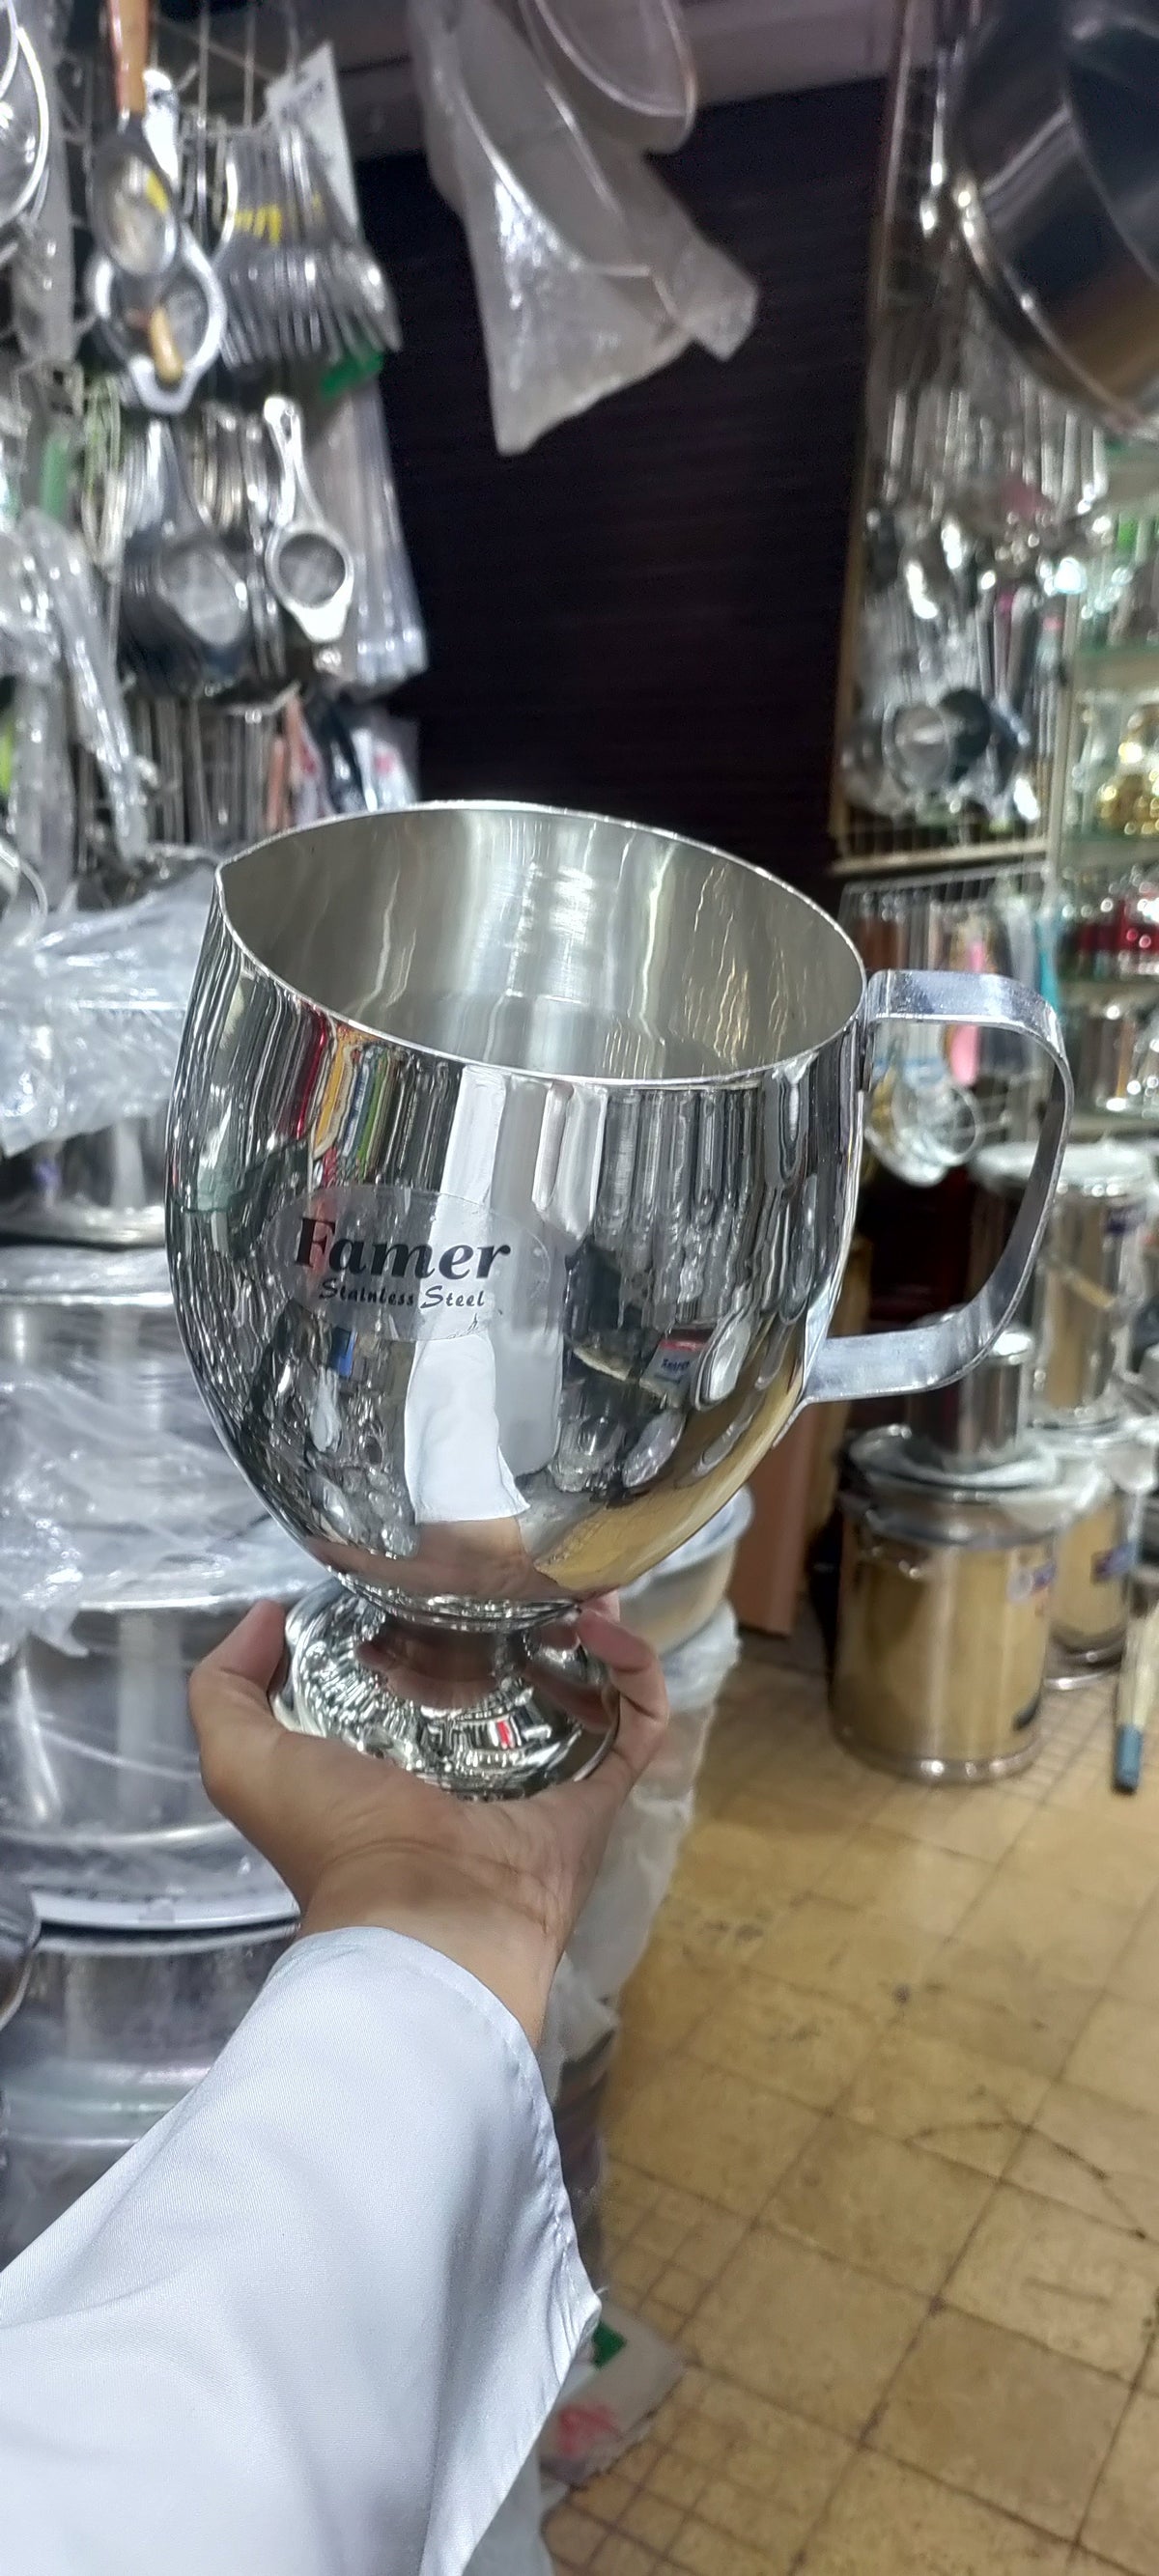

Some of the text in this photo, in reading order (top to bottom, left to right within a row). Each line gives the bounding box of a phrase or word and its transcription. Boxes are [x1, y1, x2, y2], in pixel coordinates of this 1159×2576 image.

[295, 1217, 511, 1280] Famer
[319, 1278, 485, 1308] Stainless Steel
